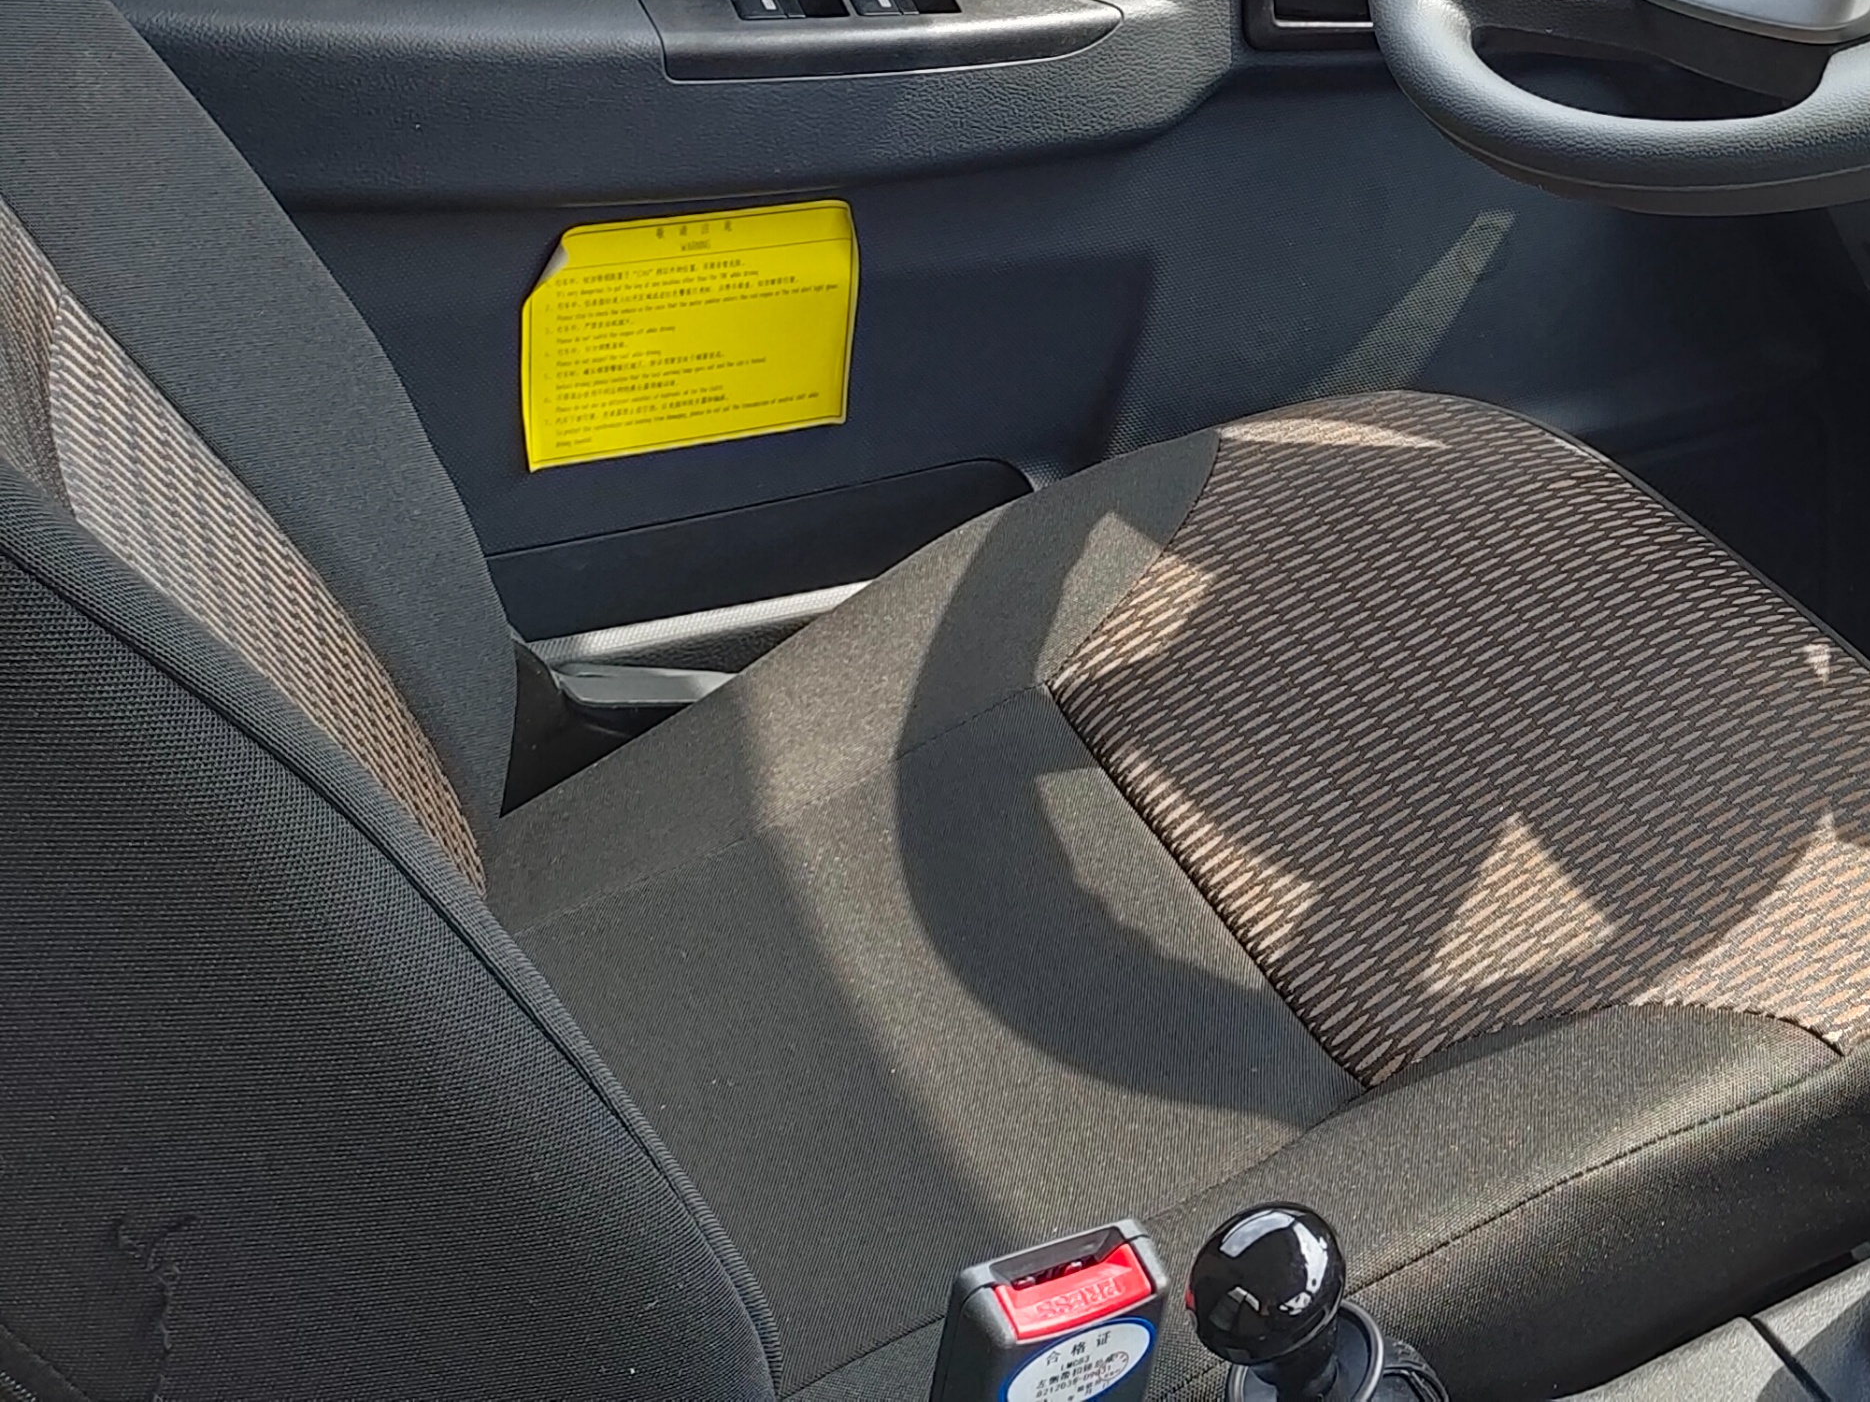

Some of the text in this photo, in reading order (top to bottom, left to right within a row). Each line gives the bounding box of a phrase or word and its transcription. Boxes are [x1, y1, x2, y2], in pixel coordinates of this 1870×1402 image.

[1036, 1278, 1123, 1318] PRESS
[1046, 1331, 1111, 1366] 合格证
